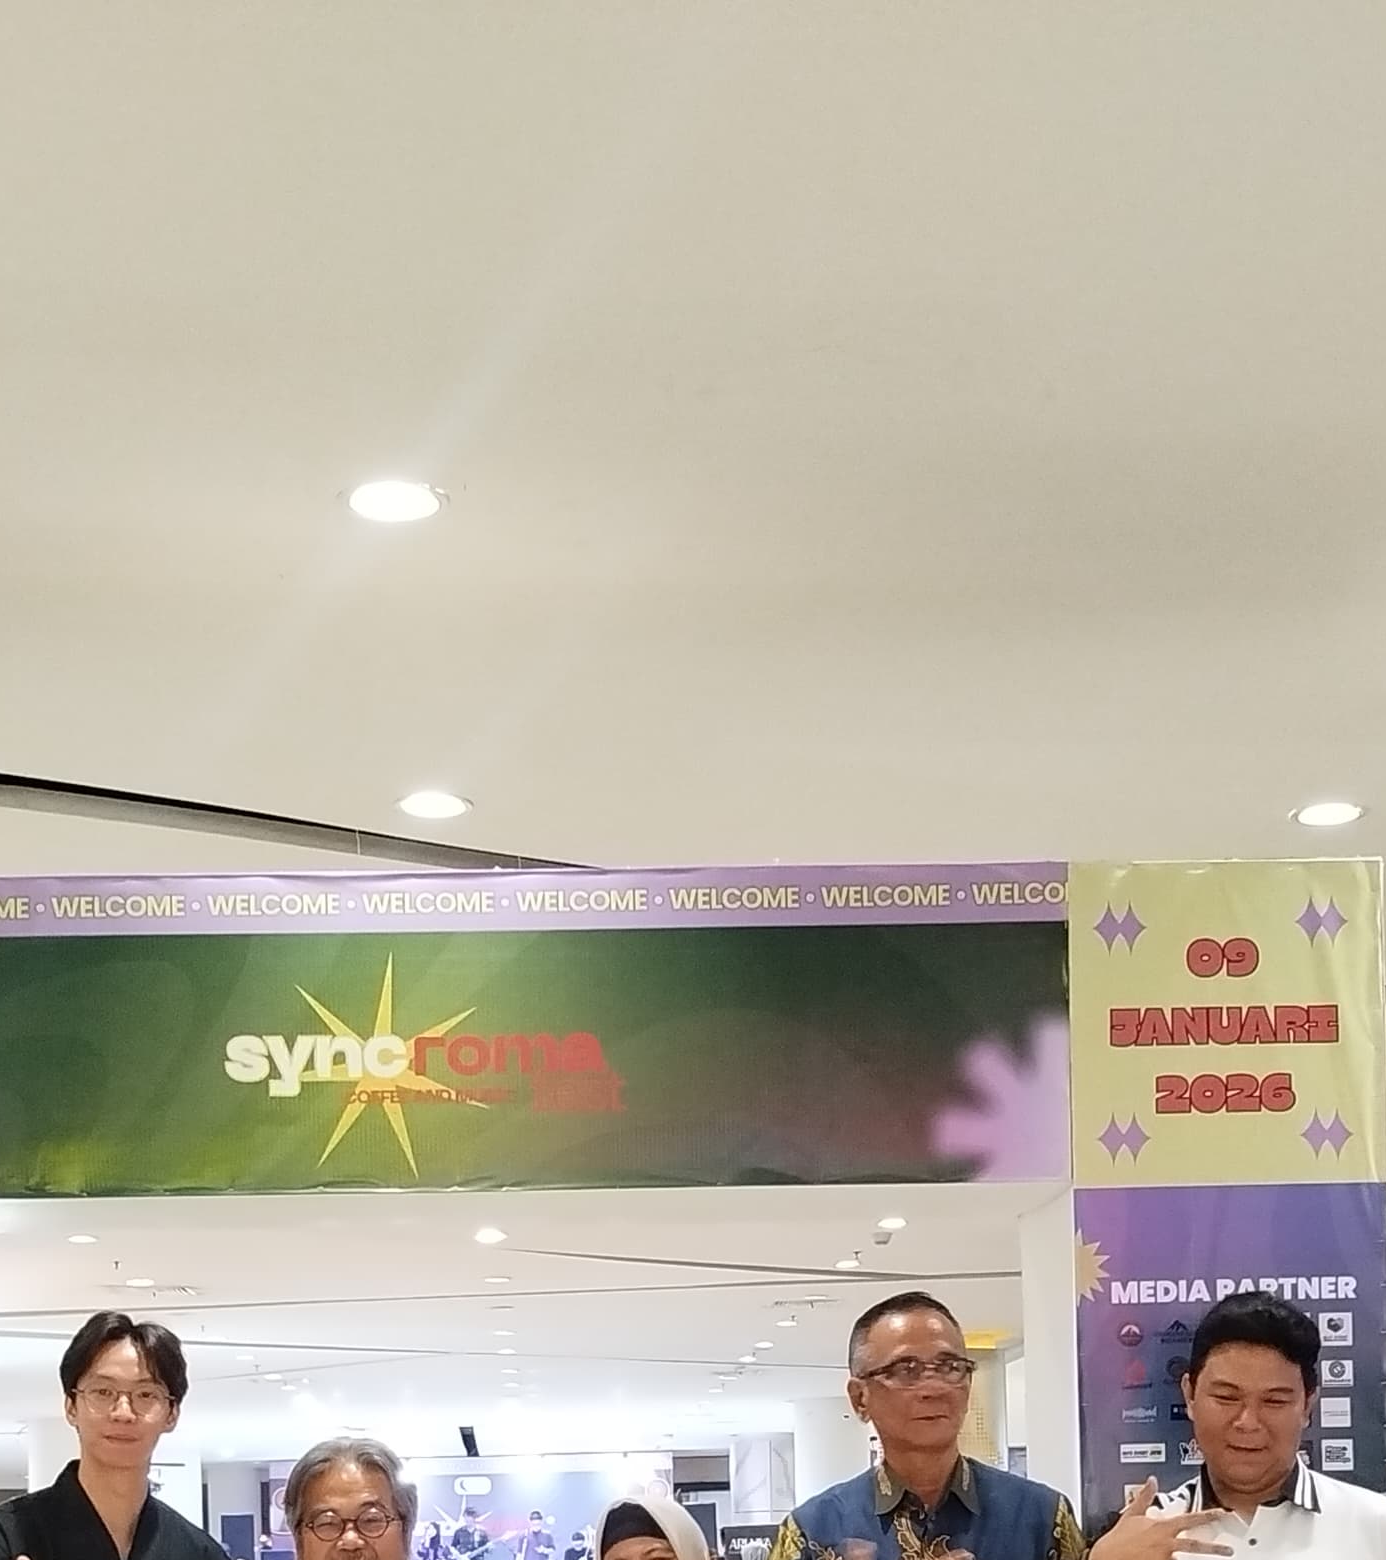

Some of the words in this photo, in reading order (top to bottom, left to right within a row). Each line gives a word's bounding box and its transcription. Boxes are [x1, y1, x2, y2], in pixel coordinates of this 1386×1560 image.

[52, 895, 185, 919] WELCOME
[208, 894, 340, 917] WELCOME
[363, 891, 494, 916] WELCOME
[516, 889, 648, 913] WELCOME
[670, 887, 800, 911] WELCOME
[822, 885, 951, 909] WELCOME
[973, 883, 1068, 906] WELCO
[1186, 938, 1259, 978] 09
[1109, 1004, 1340, 1047] JANUARI
[224, 1031, 608, 1098] syncroma
[1155, 1073, 1296, 1114] 2026
[1111, 1279, 1211, 1305] MEDIA
[1215, 1276, 1358, 1301] PARTNER
